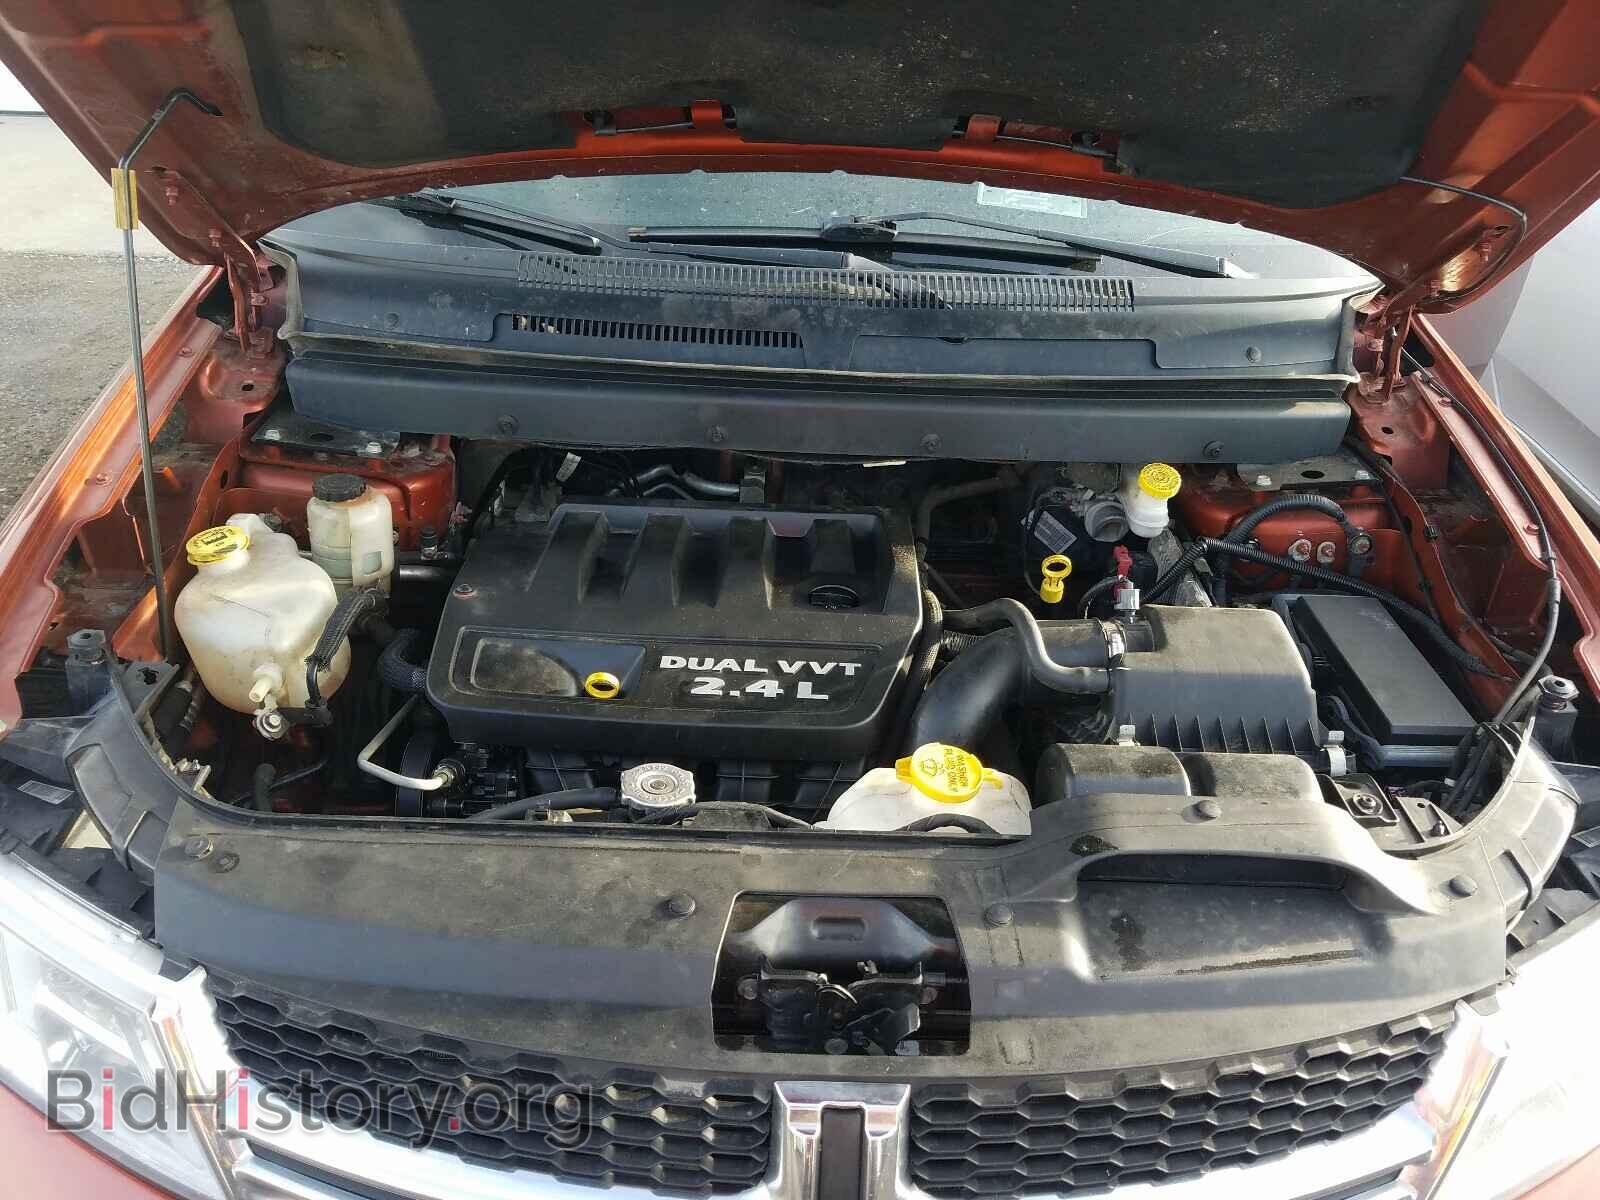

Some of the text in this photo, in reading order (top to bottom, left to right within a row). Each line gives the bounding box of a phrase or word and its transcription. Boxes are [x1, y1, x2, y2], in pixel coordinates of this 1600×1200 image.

[659, 655, 862, 676] DUAL VVT
[690, 676, 829, 701] 2.4 L
